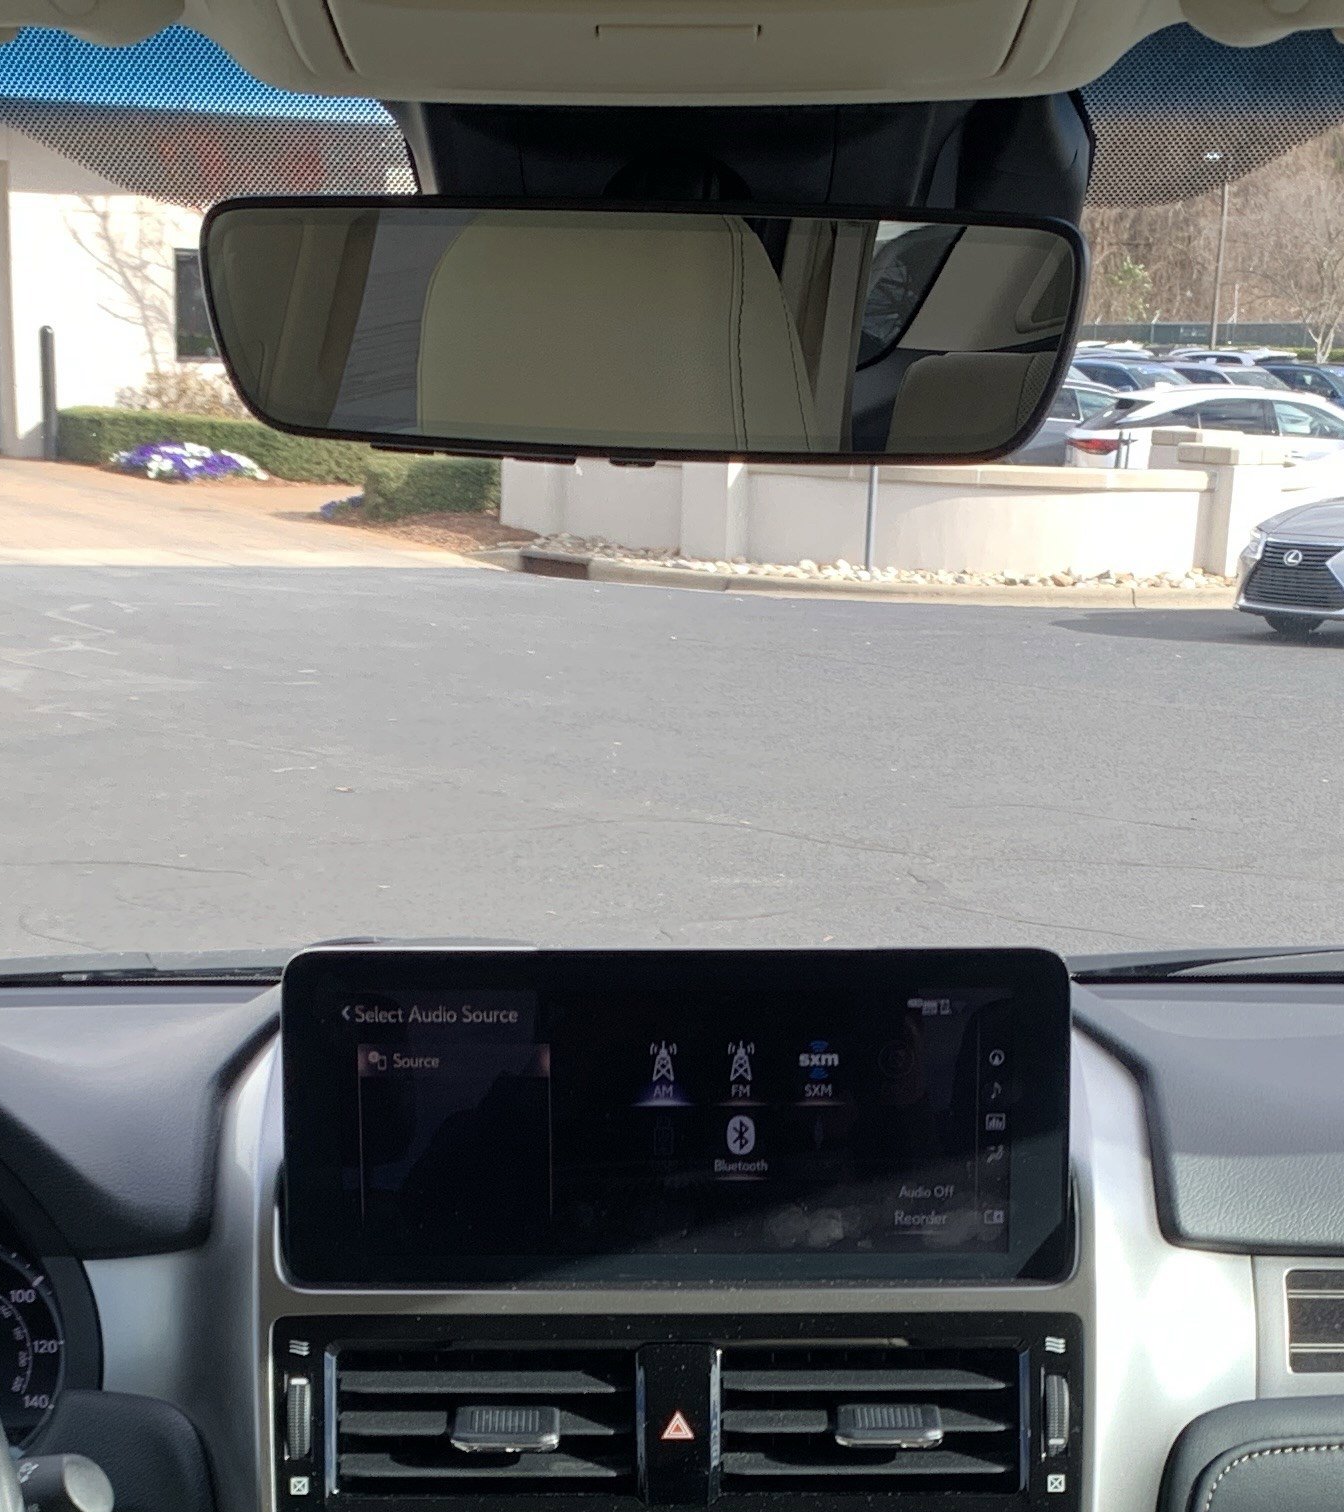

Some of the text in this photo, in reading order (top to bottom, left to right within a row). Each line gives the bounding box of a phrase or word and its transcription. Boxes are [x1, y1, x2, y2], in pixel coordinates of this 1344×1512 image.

[355, 1005, 518, 1023] Select Audio Source
[393, 1053, 440, 1068] Source
[654, 1085, 673, 1097] AM
[731, 1085, 751, 1097] FM
[804, 1084, 833, 1097] SXM
[714, 1159, 768, 1173] Bluetooth
[899, 1185, 955, 1198] Audio Off
[894, 1210, 947, 1225] Reorder
[9, 1289, 36, 1304] 100
[33, 1339, 58, 1354] 120
[23, 1395, 49, 1410] 140
